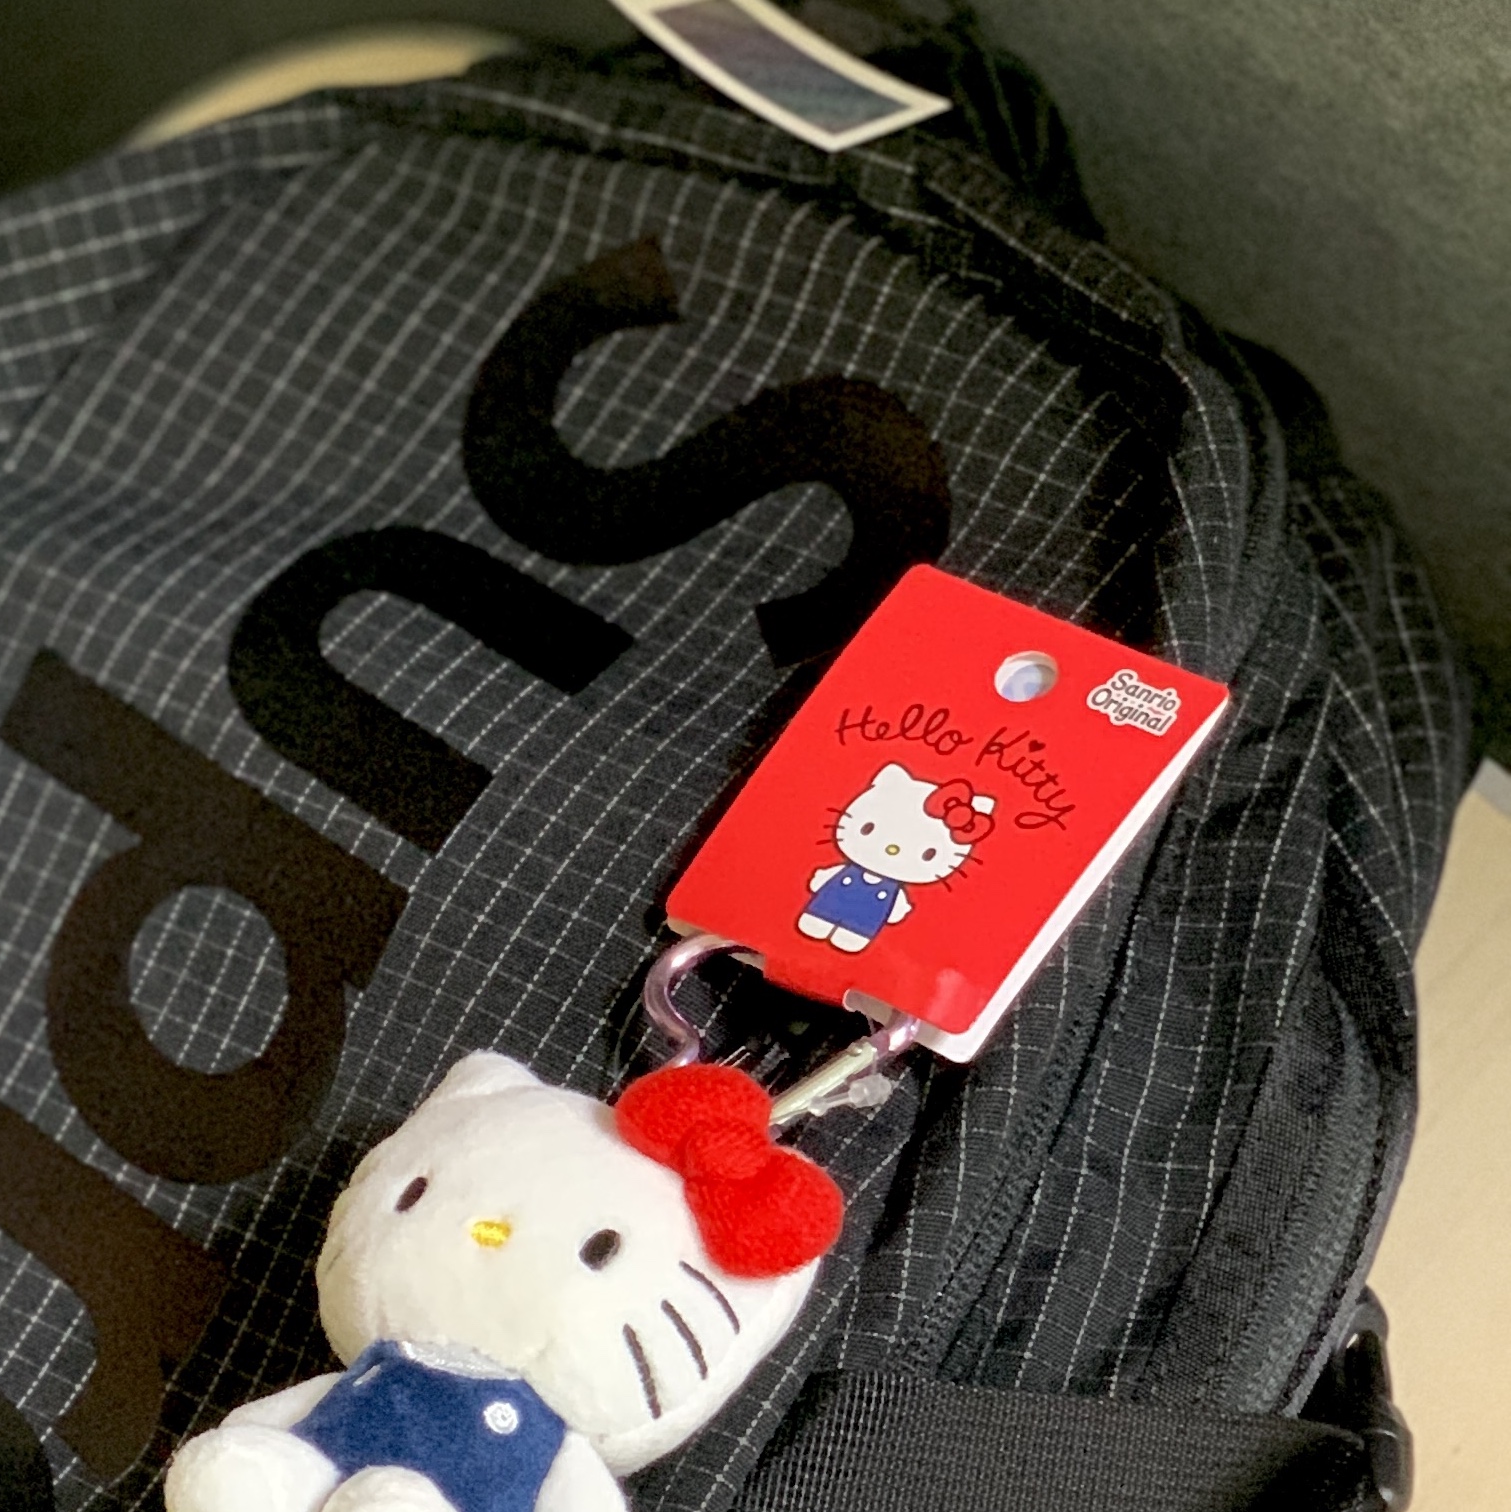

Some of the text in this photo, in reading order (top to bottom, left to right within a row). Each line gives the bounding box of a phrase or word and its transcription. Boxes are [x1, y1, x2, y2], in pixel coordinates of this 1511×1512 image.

[1090, 687, 1173, 732] Original
[1110, 672, 1177, 711] Sanrio
[835, 703, 1076, 830] Hello Kitty
